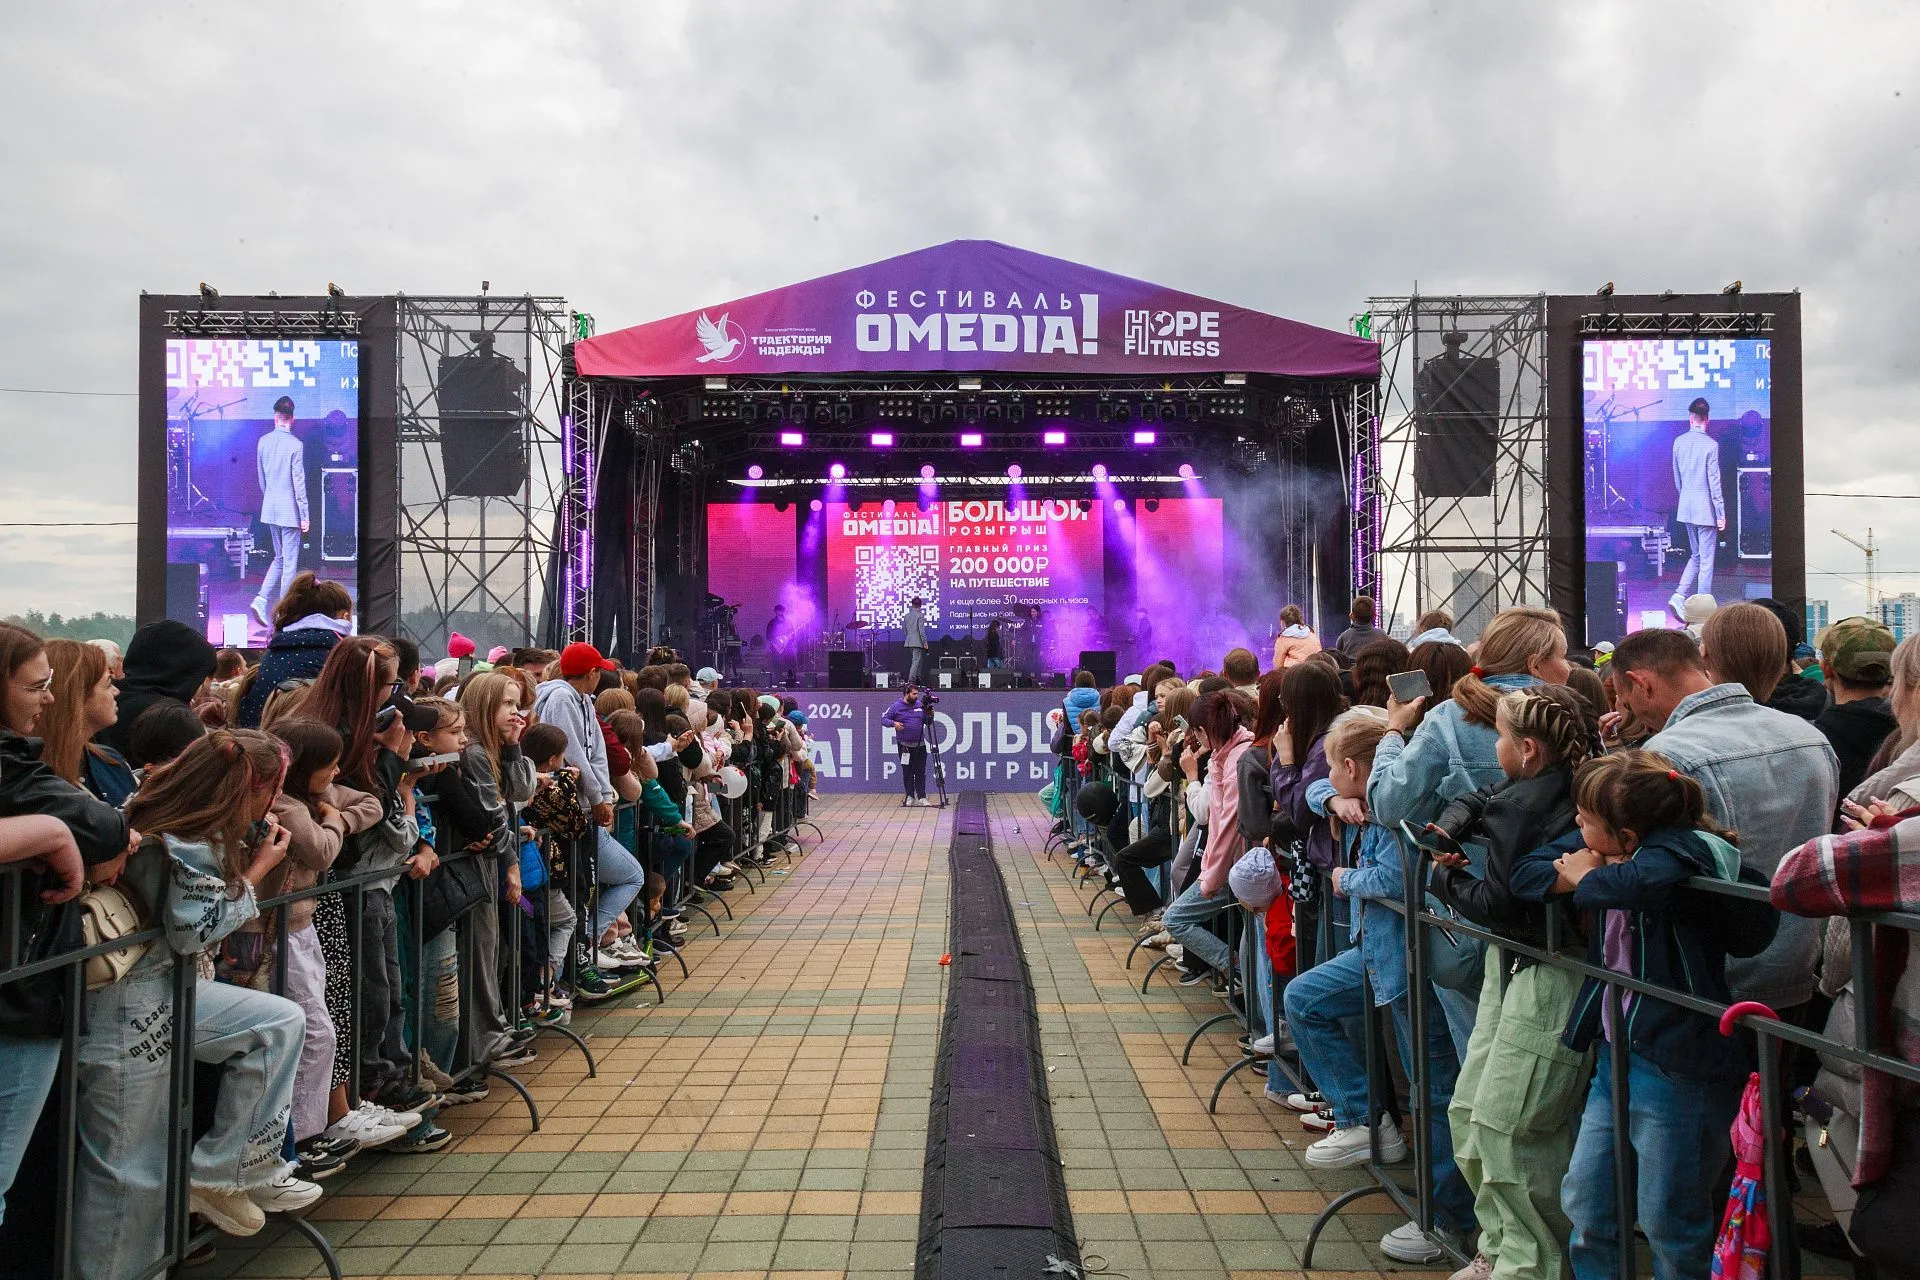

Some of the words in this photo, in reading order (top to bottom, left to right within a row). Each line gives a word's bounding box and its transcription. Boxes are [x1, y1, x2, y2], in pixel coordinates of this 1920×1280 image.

[855, 289, 1073, 310] ФЕСТИВАЛЬ
[856, 293, 1099, 355] OMEDIA!
[751, 335, 832, 345] ТРАЕКТОРИЯ
[759, 346, 824, 357] НАДЕЖДЫ
[1125, 339, 1220, 356] FITNESS
[843, 511, 917, 519] ФЕСТИВАЛЬ
[843, 514, 940, 536] OMEDIA!
[949, 525, 1047, 536] РОЗЫГРЫШ
[949, 544, 1008, 553] ГЛАВНЫЙ
[1016, 544, 1048, 552] ПРИЗ
[949, 557, 988, 574] 200
[950, 578, 967, 588] НА
[969, 577, 1050, 588] ПУТЕШЕСТВИЕ
[975, 597, 1001, 605] более
[1002, 594, 1018, 605] 30
[808, 703, 852, 719] 2024
[883, 761, 1049, 780] РЗЫГРЫ
